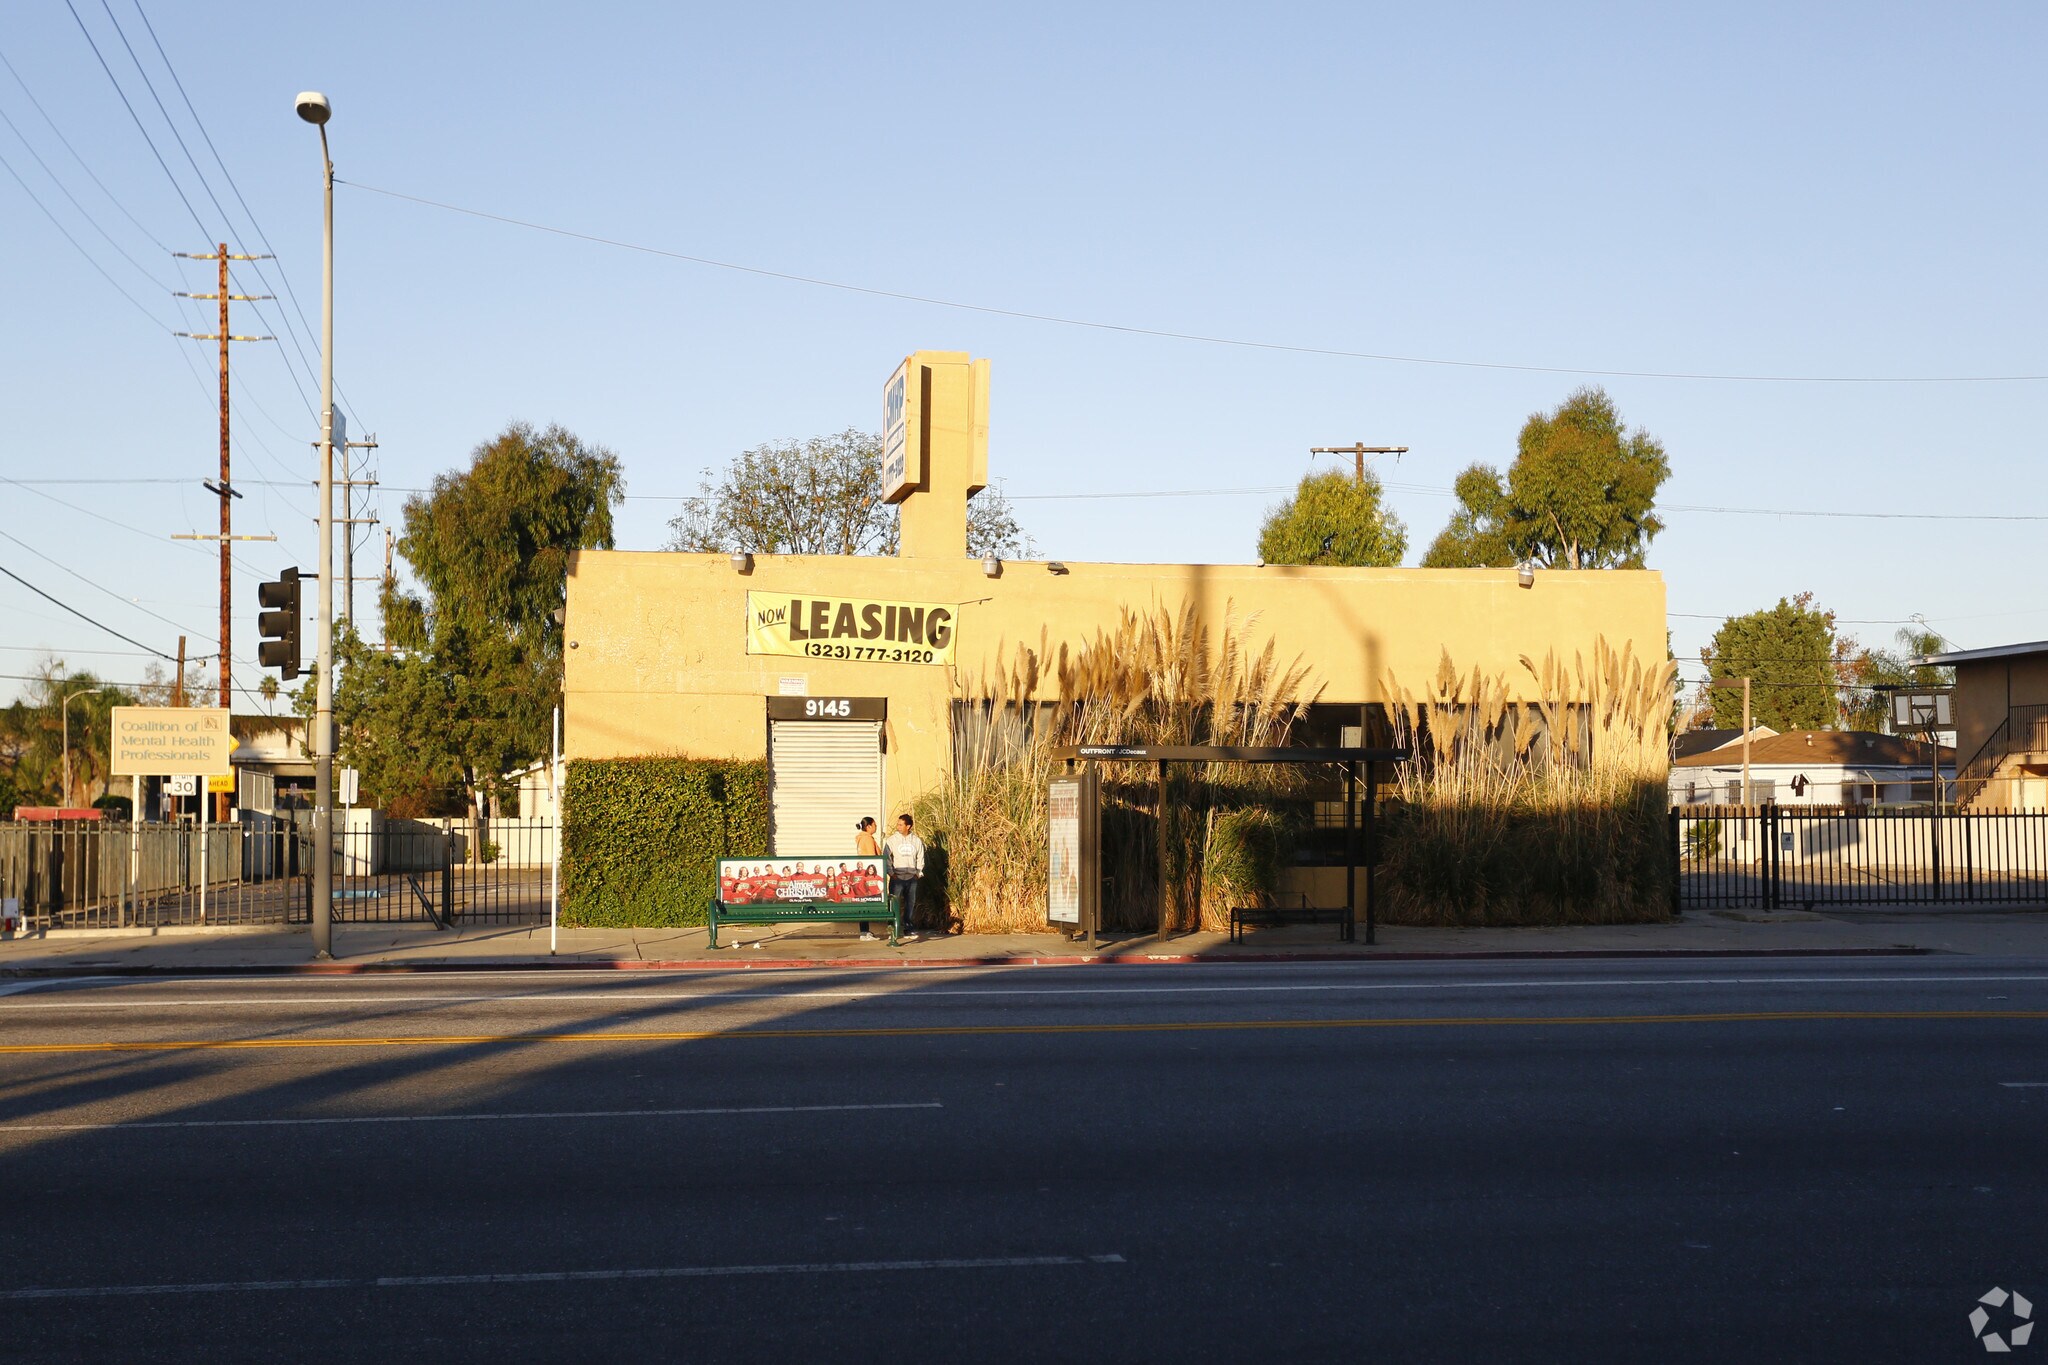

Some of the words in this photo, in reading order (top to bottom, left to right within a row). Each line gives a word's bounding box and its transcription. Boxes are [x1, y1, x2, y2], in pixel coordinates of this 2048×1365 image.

[757, 605, 786, 626] NOW
[789, 599, 951, 649] LEASING
[804, 642, 850, 659] (323)
[854, 647, 934, 663] 777-3120
[805, 699, 851, 716] 9145
[120, 721, 180, 732] Coalition
[185, 720, 199, 732] of
[120, 735, 166, 747] Mental
[171, 735, 215, 747] Health
[120, 750, 211, 760] Professionals
[174, 781, 193, 792] 30
[775, 887, 827, 898] CHRISTMAS
